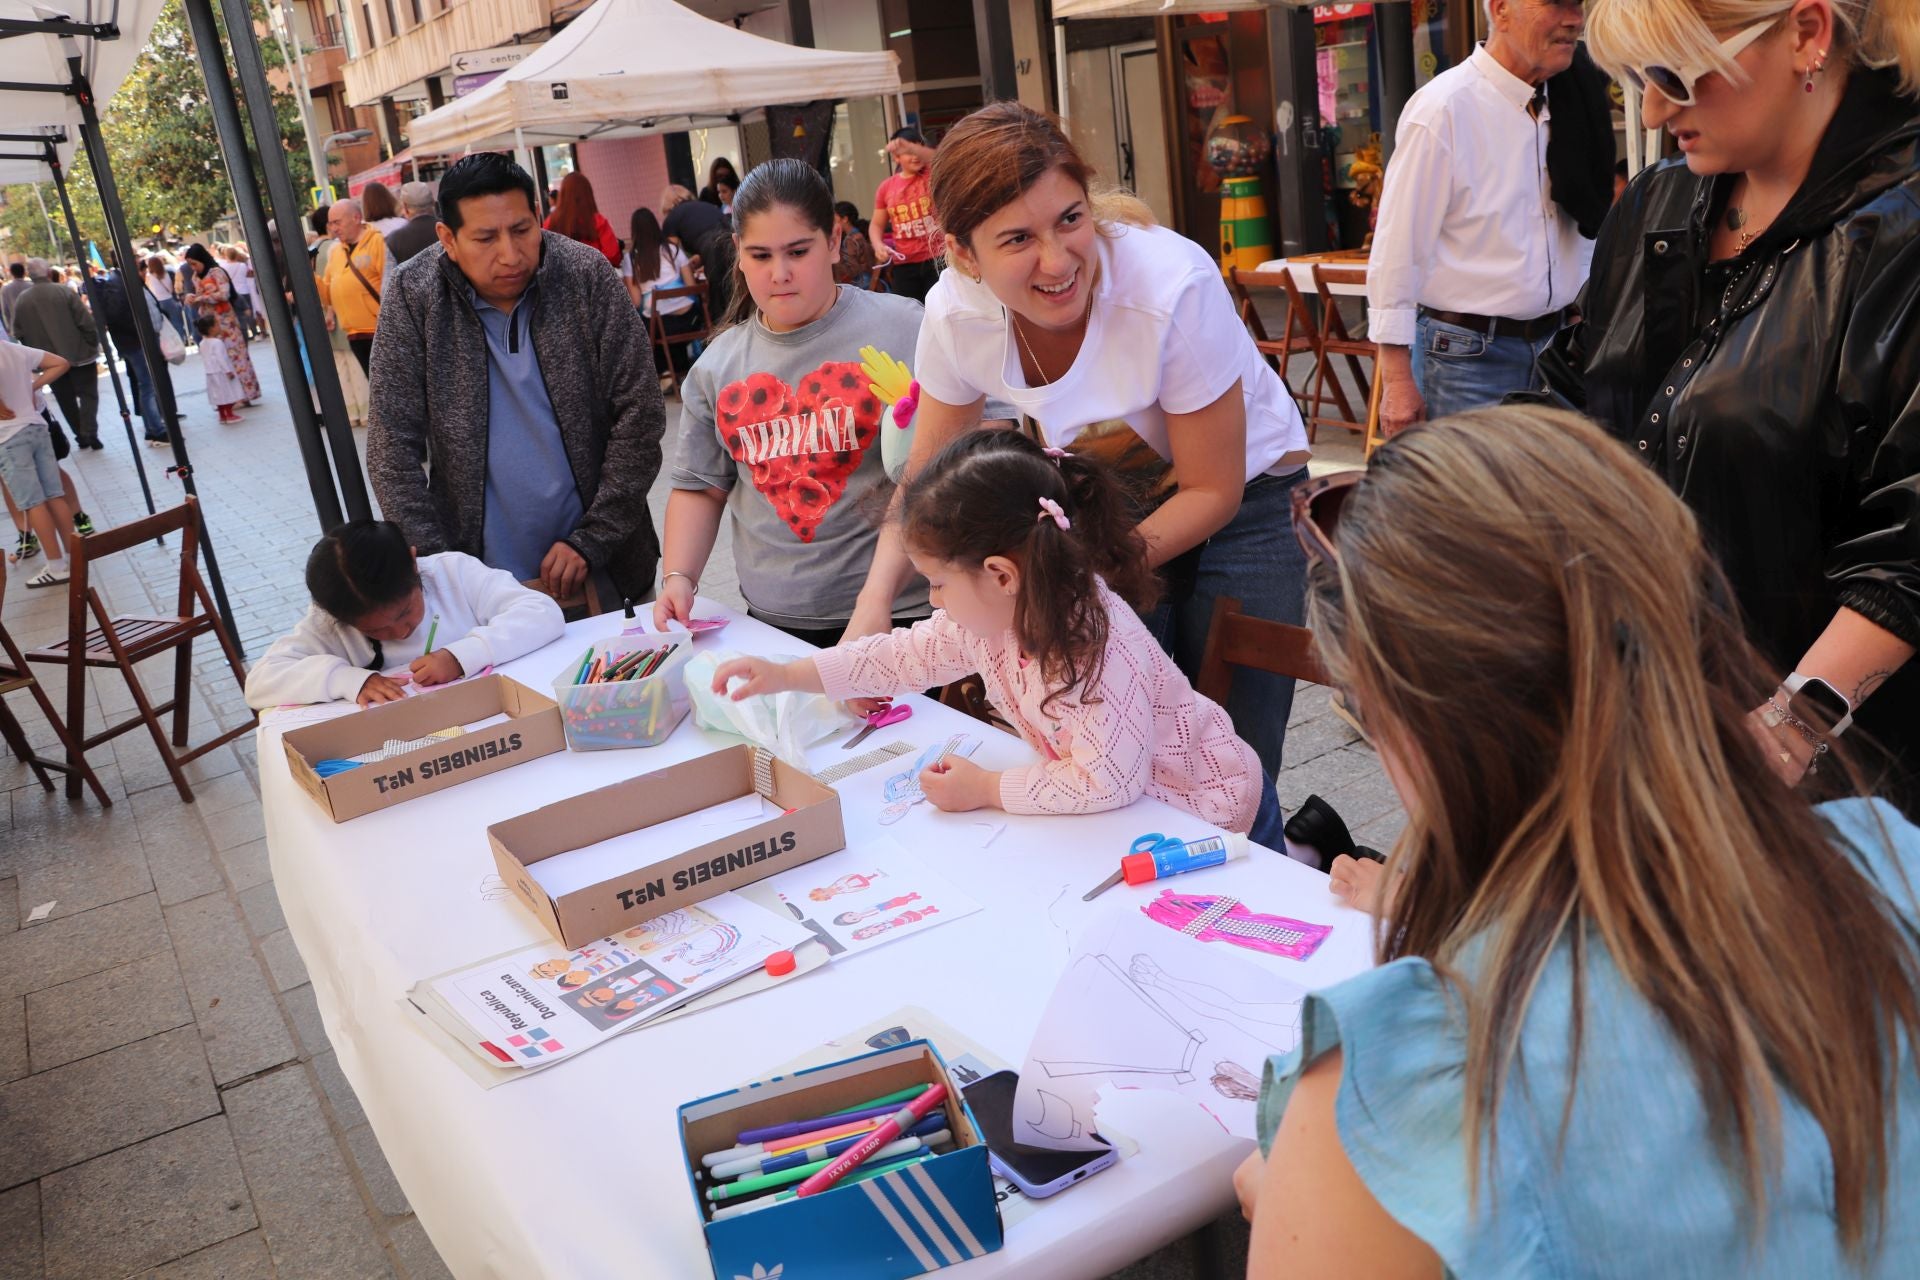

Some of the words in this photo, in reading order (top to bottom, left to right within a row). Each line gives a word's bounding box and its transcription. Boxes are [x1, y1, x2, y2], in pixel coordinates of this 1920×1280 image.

[489, 53, 521, 64] centro
[736, 406, 860, 465] NIRVANA
[419, 733, 522, 779] STEINBEIS
[672, 831, 796, 891] STEINBEIS
[480, 990, 528, 1030] República
[500, 973, 557, 1020] Dominicana
[862, 1137, 880, 1155] JOVI
[828, 1159, 852, 1179] MAXI
